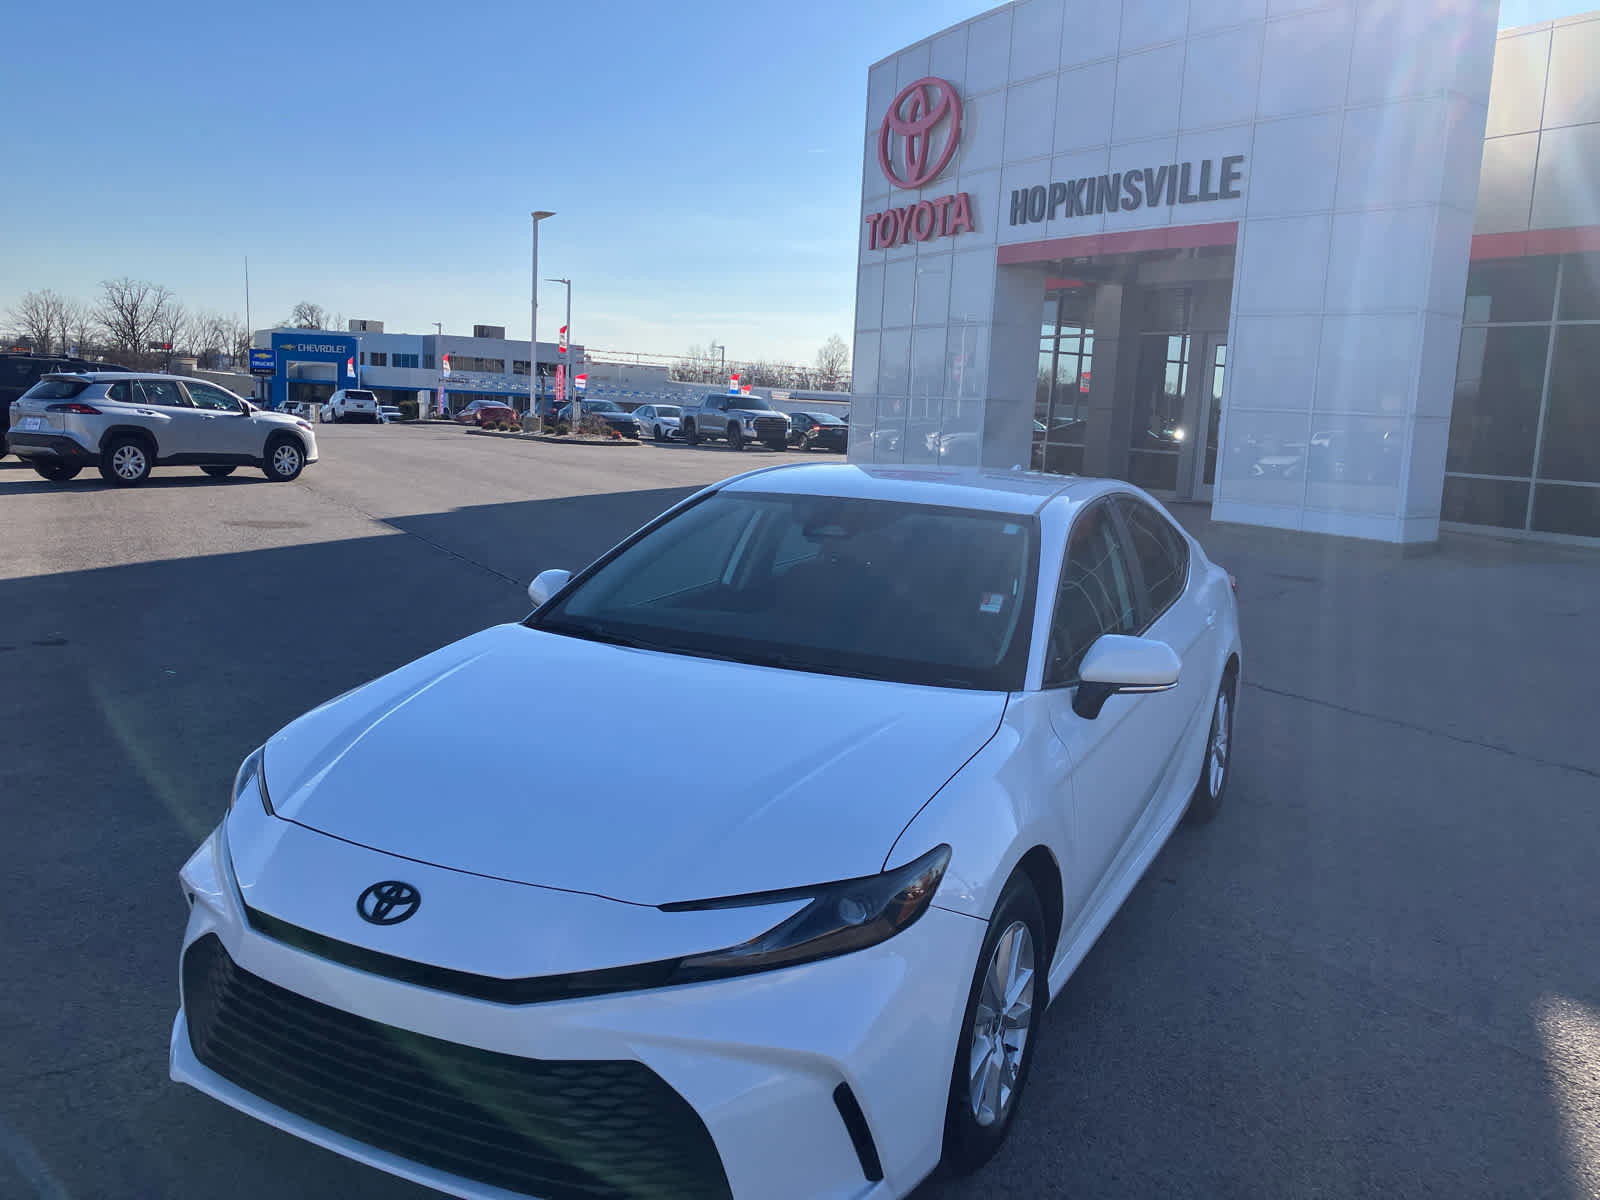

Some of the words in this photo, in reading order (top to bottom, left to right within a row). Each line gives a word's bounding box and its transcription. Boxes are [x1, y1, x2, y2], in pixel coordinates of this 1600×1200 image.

[1009, 155, 1243, 225] HOPKINSVILLE
[866, 192, 975, 250] TOYOTA
[297, 344, 346, 353] CHEVROLET
